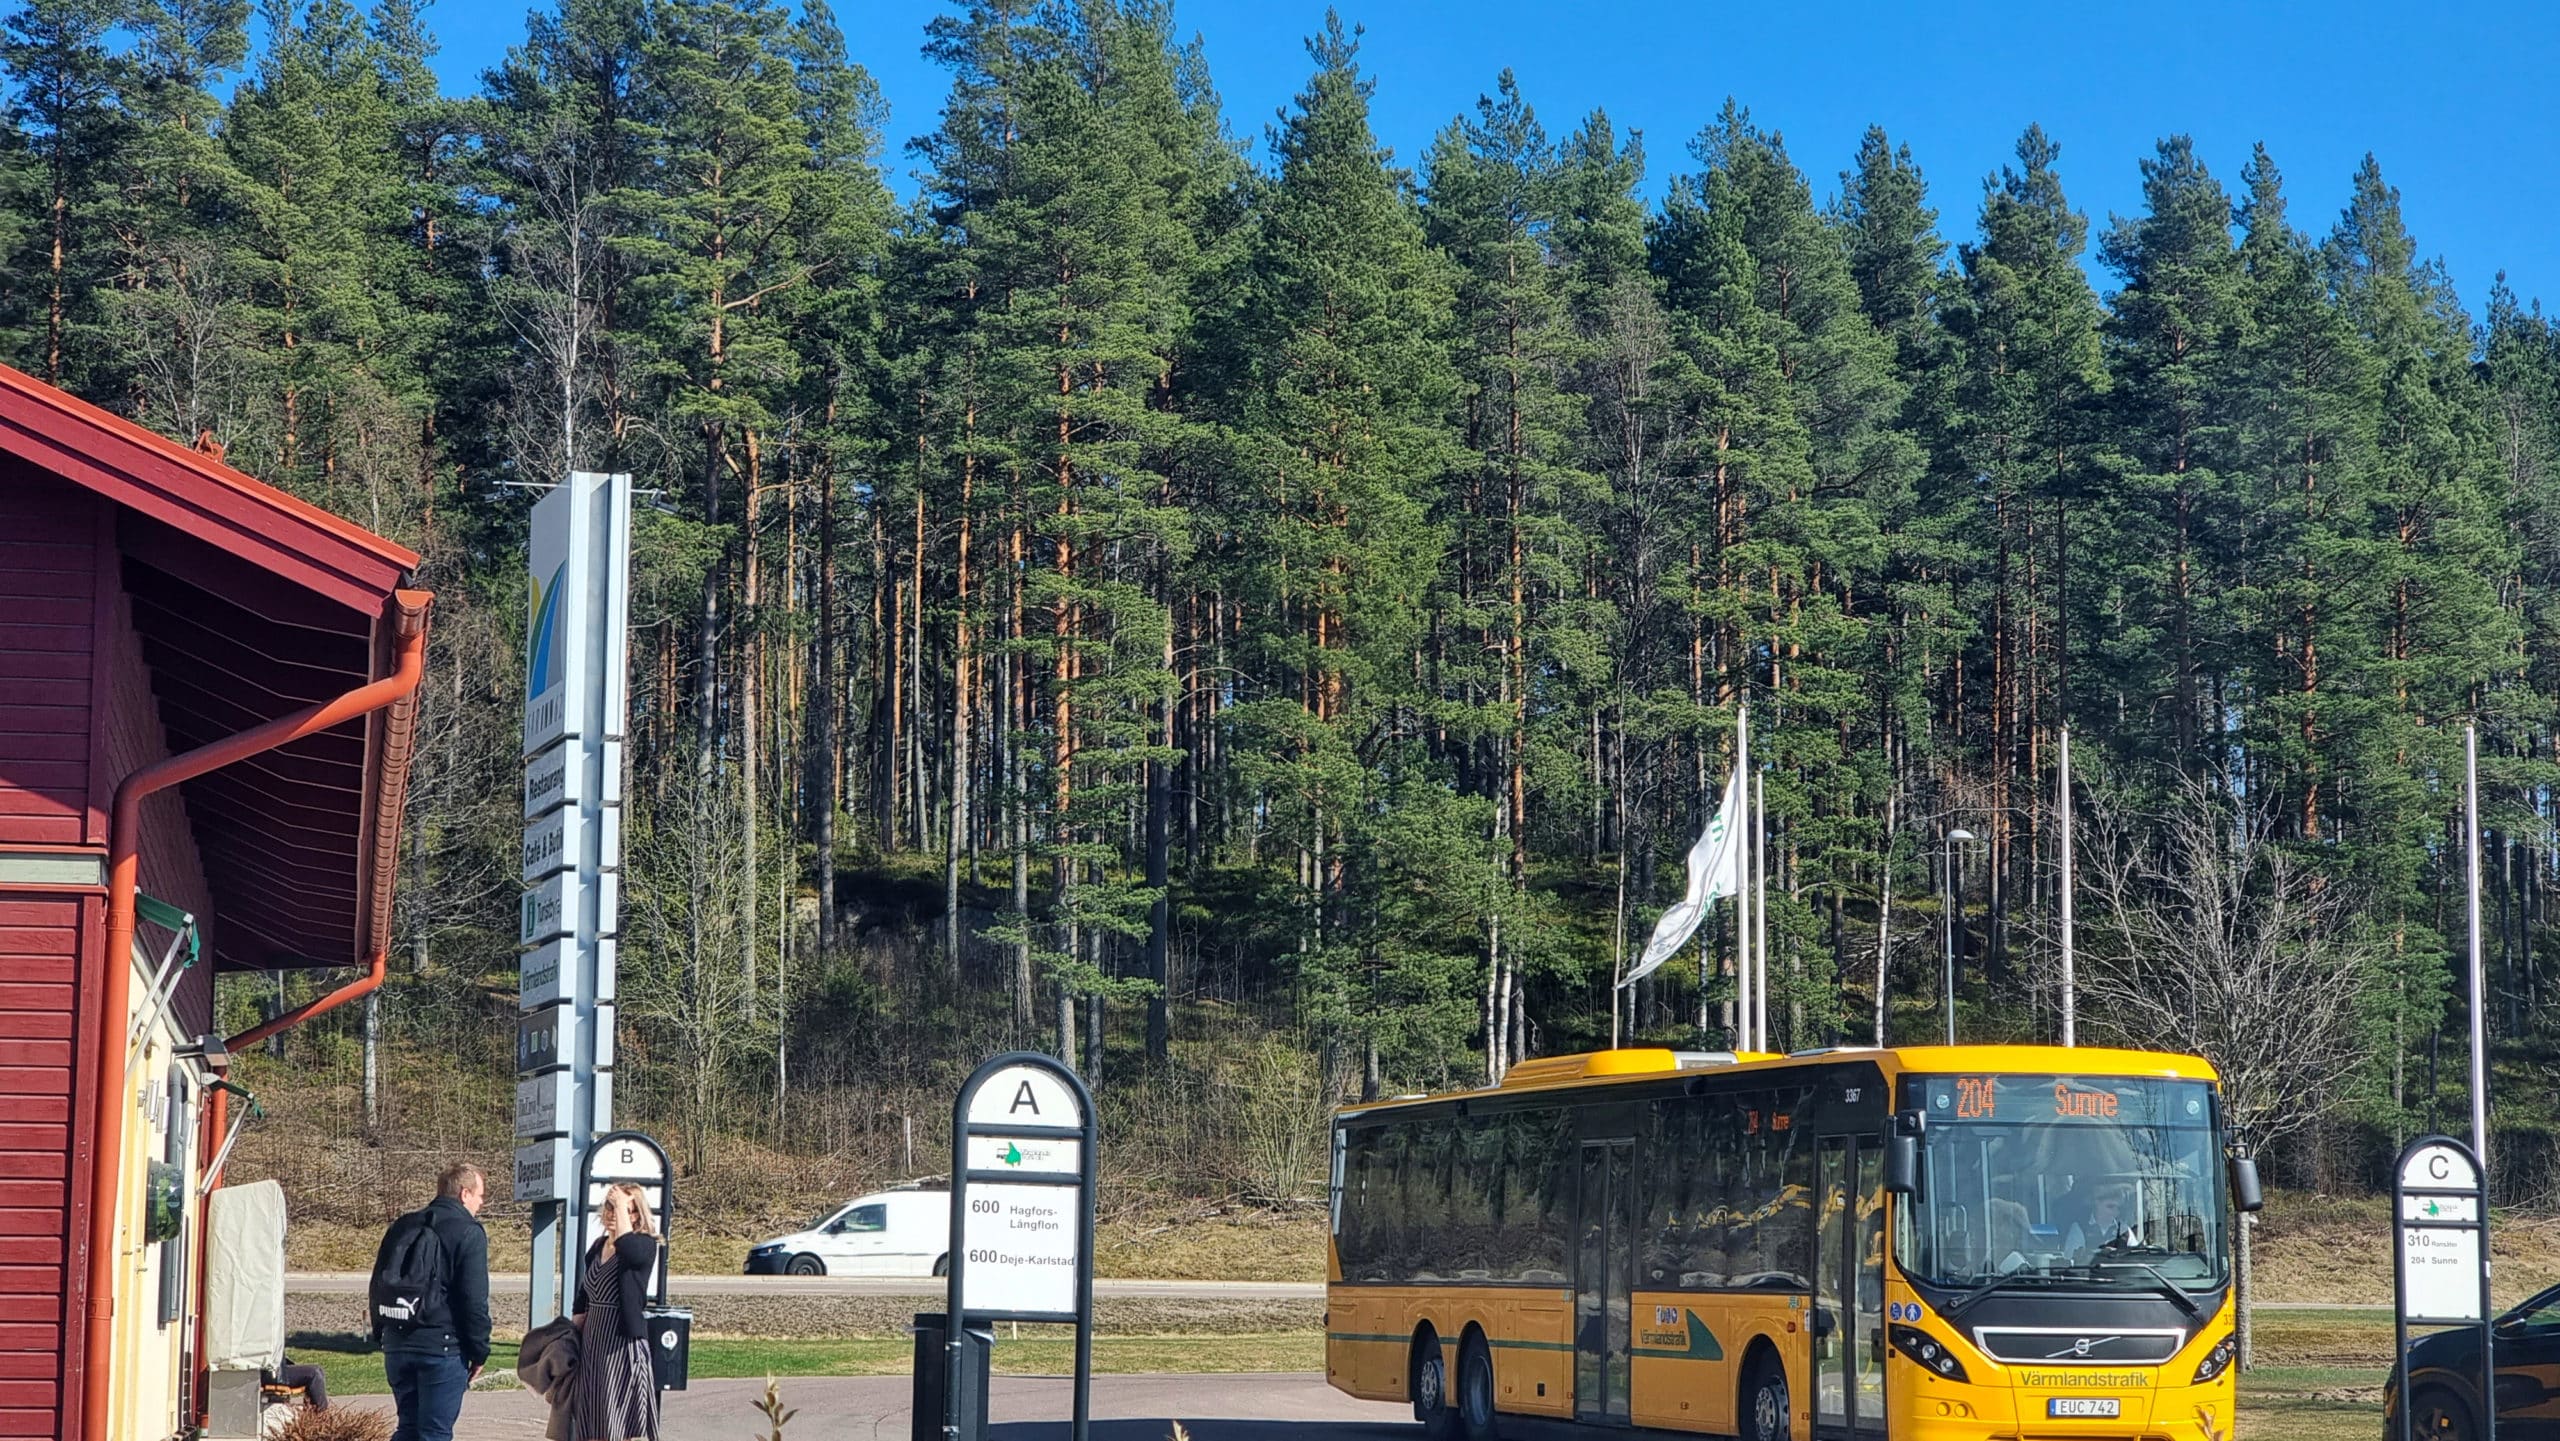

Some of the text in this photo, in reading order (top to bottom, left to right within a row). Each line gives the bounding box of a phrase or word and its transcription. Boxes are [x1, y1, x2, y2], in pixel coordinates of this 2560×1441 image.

[1009, 1080, 1041, 1115] A
[1957, 1078, 2118, 1118] 204 Sunne
[620, 1148, 634, 1164] B
[2428, 1155, 2449, 1180] C
[972, 1199, 1058, 1218] 600 Hagfors-
[1009, 1219, 1059, 1232] Långflon
[2408, 1234, 2430, 1247] 310
[969, 1250, 1075, 1267] 600 Deje-Karlstad
[2410, 1256, 2458, 1265] 204 Sunne
[2020, 1370, 2149, 1388] Värmlandstrafik
[2059, 1400, 2115, 1414] EUC 742
